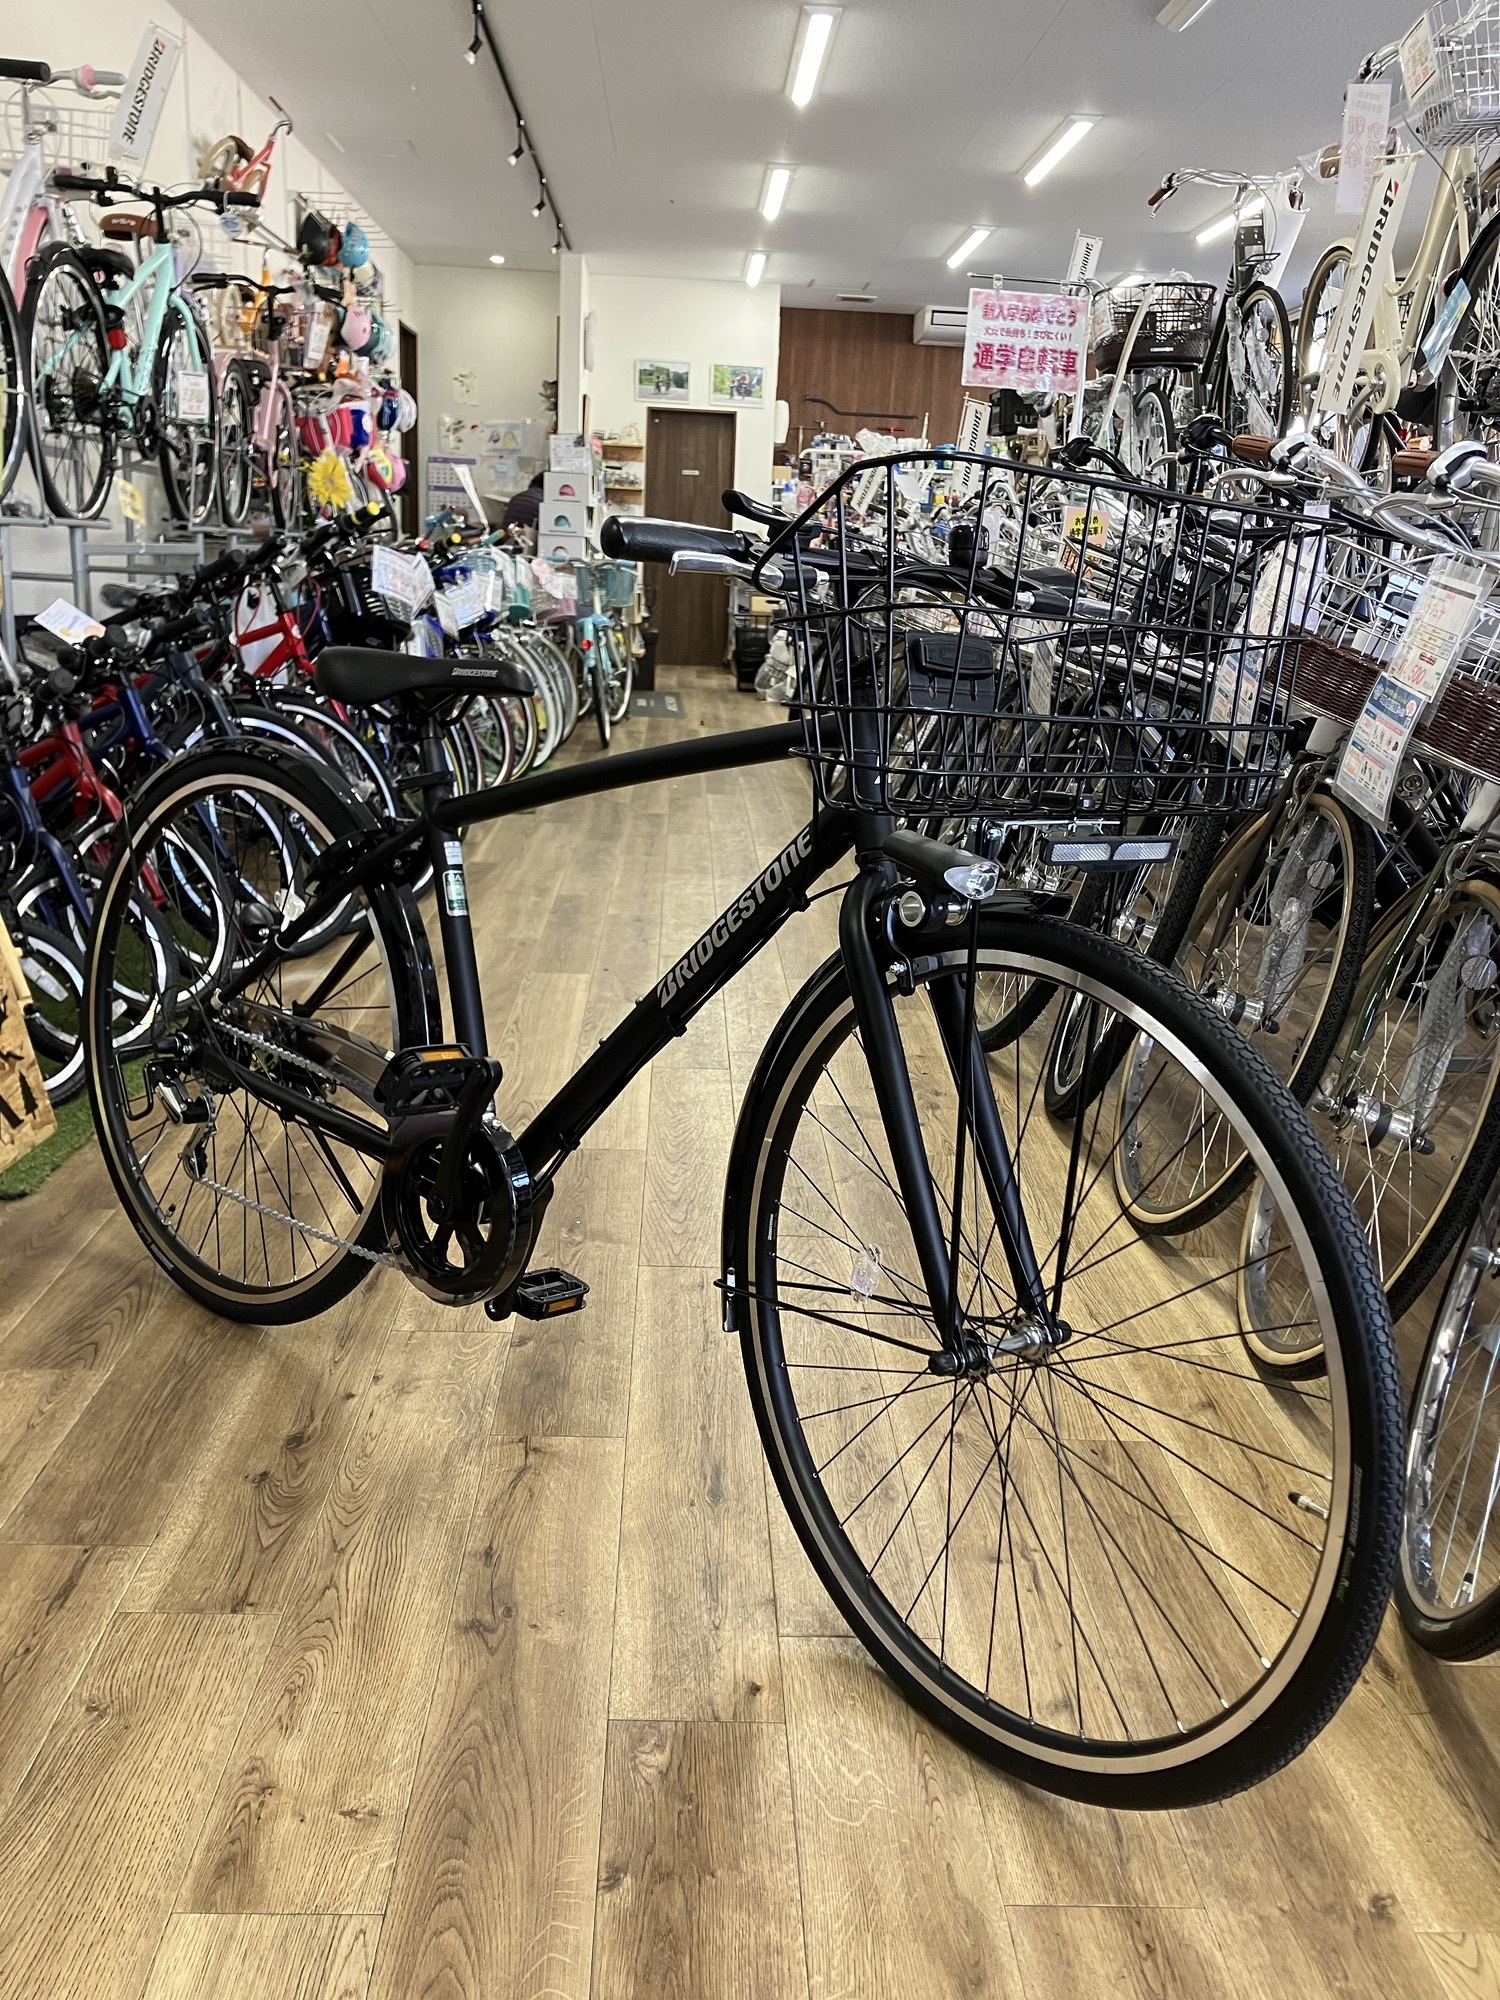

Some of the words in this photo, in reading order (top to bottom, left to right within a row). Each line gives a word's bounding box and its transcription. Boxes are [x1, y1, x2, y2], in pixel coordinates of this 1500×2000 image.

[122, 38, 165, 146] BRIDGESTONE
[982, 303, 1077, 327] 新入学おめでとう
[1332, 178, 1400, 402] BRIDGESTONE
[973, 342, 1079, 378] 通学自転車
[451, 667, 499, 678] BRIDGESTONE
[656, 826, 812, 1009] BRIDGESTONE
